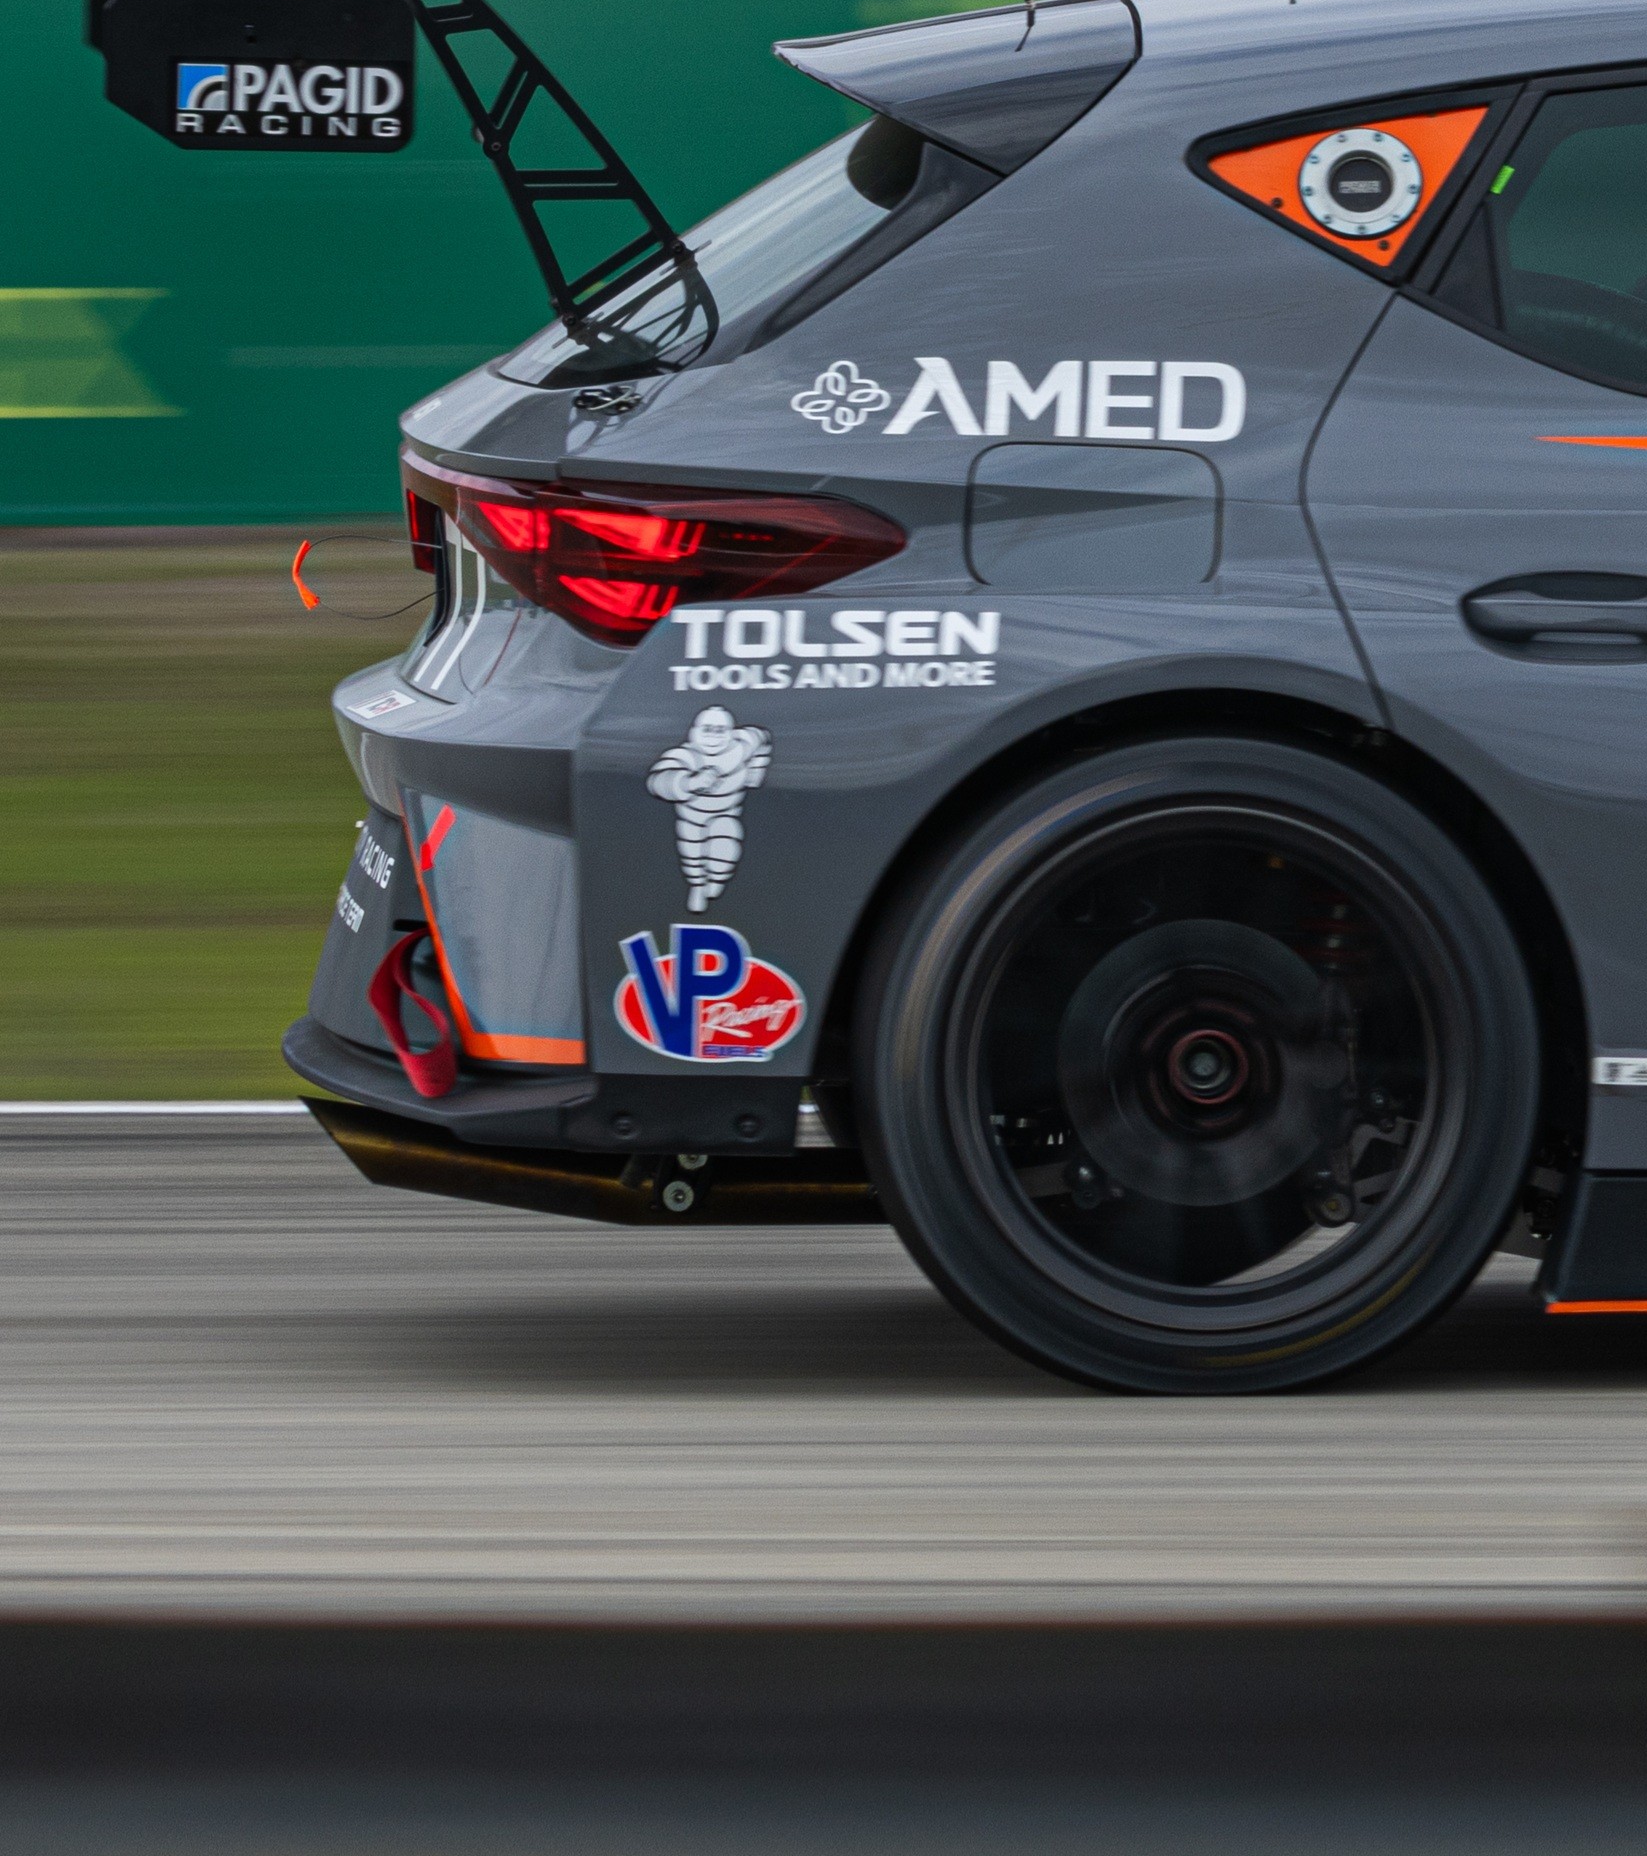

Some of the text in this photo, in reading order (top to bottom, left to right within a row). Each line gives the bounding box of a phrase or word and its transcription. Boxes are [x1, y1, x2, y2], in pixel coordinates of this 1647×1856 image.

[231, 64, 403, 116] PAGID
[176, 112, 402, 138] RACING
[882, 356, 1247, 443] AMED
[670, 609, 1000, 659] TOLSEN
[668, 660, 997, 691] TOOLS AND MORE
[618, 923, 752, 1059] VP
